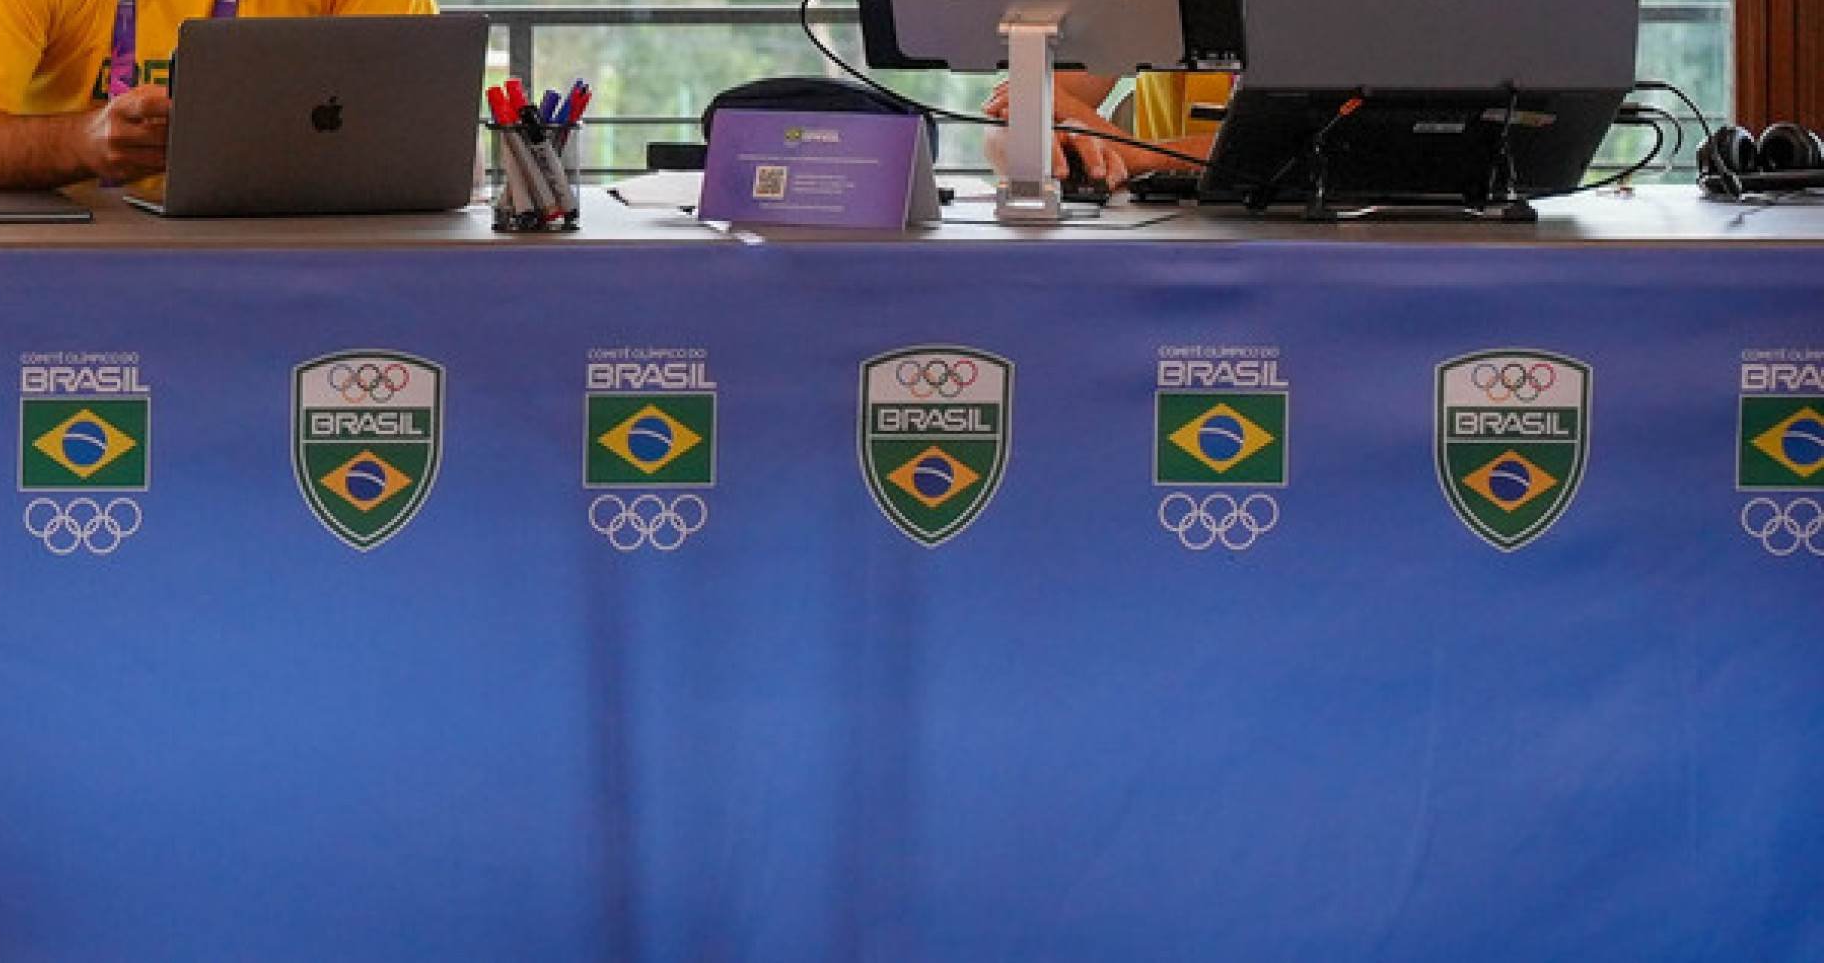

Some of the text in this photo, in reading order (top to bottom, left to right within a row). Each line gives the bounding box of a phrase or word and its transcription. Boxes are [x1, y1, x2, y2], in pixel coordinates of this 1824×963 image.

[22, 366, 152, 392] BRASIL
[587, 363, 718, 389] BRASIL
[1158, 360, 1289, 386] BRASIL
[311, 412, 423, 435] BRASIL
[877, 408, 992, 431] BRASIL
[1455, 412, 1569, 435] BRASIL
